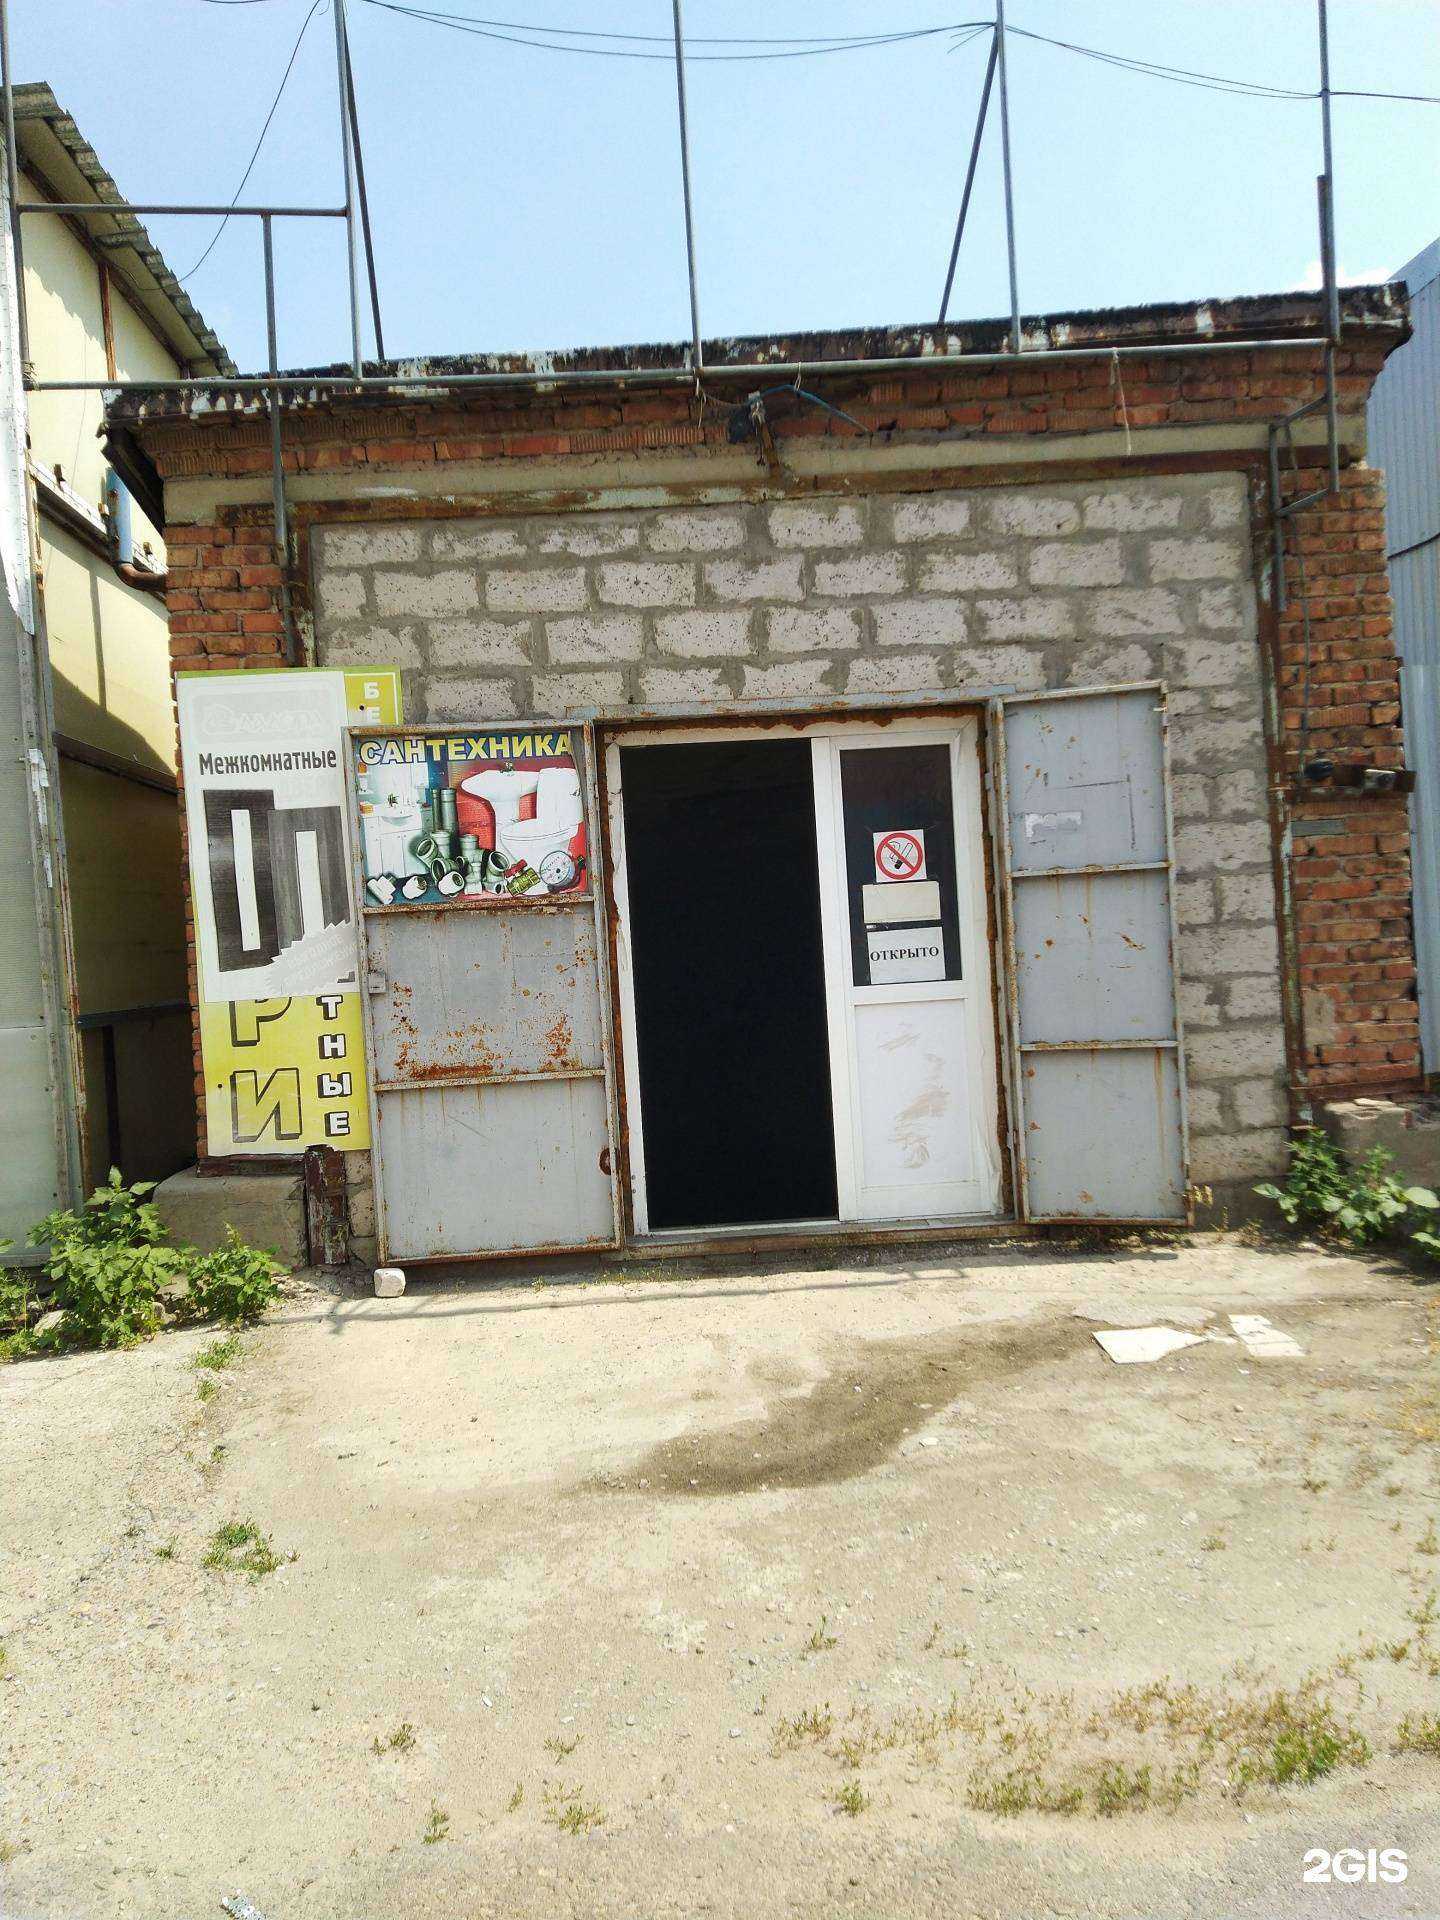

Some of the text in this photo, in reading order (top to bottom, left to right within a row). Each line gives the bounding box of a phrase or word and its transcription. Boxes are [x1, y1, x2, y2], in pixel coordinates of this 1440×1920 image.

[200, 749, 337, 776] Межкомнатные
[361, 733, 571, 765] САНТЕХНИКА
[870, 946, 939, 962] ОТКРЫТО
